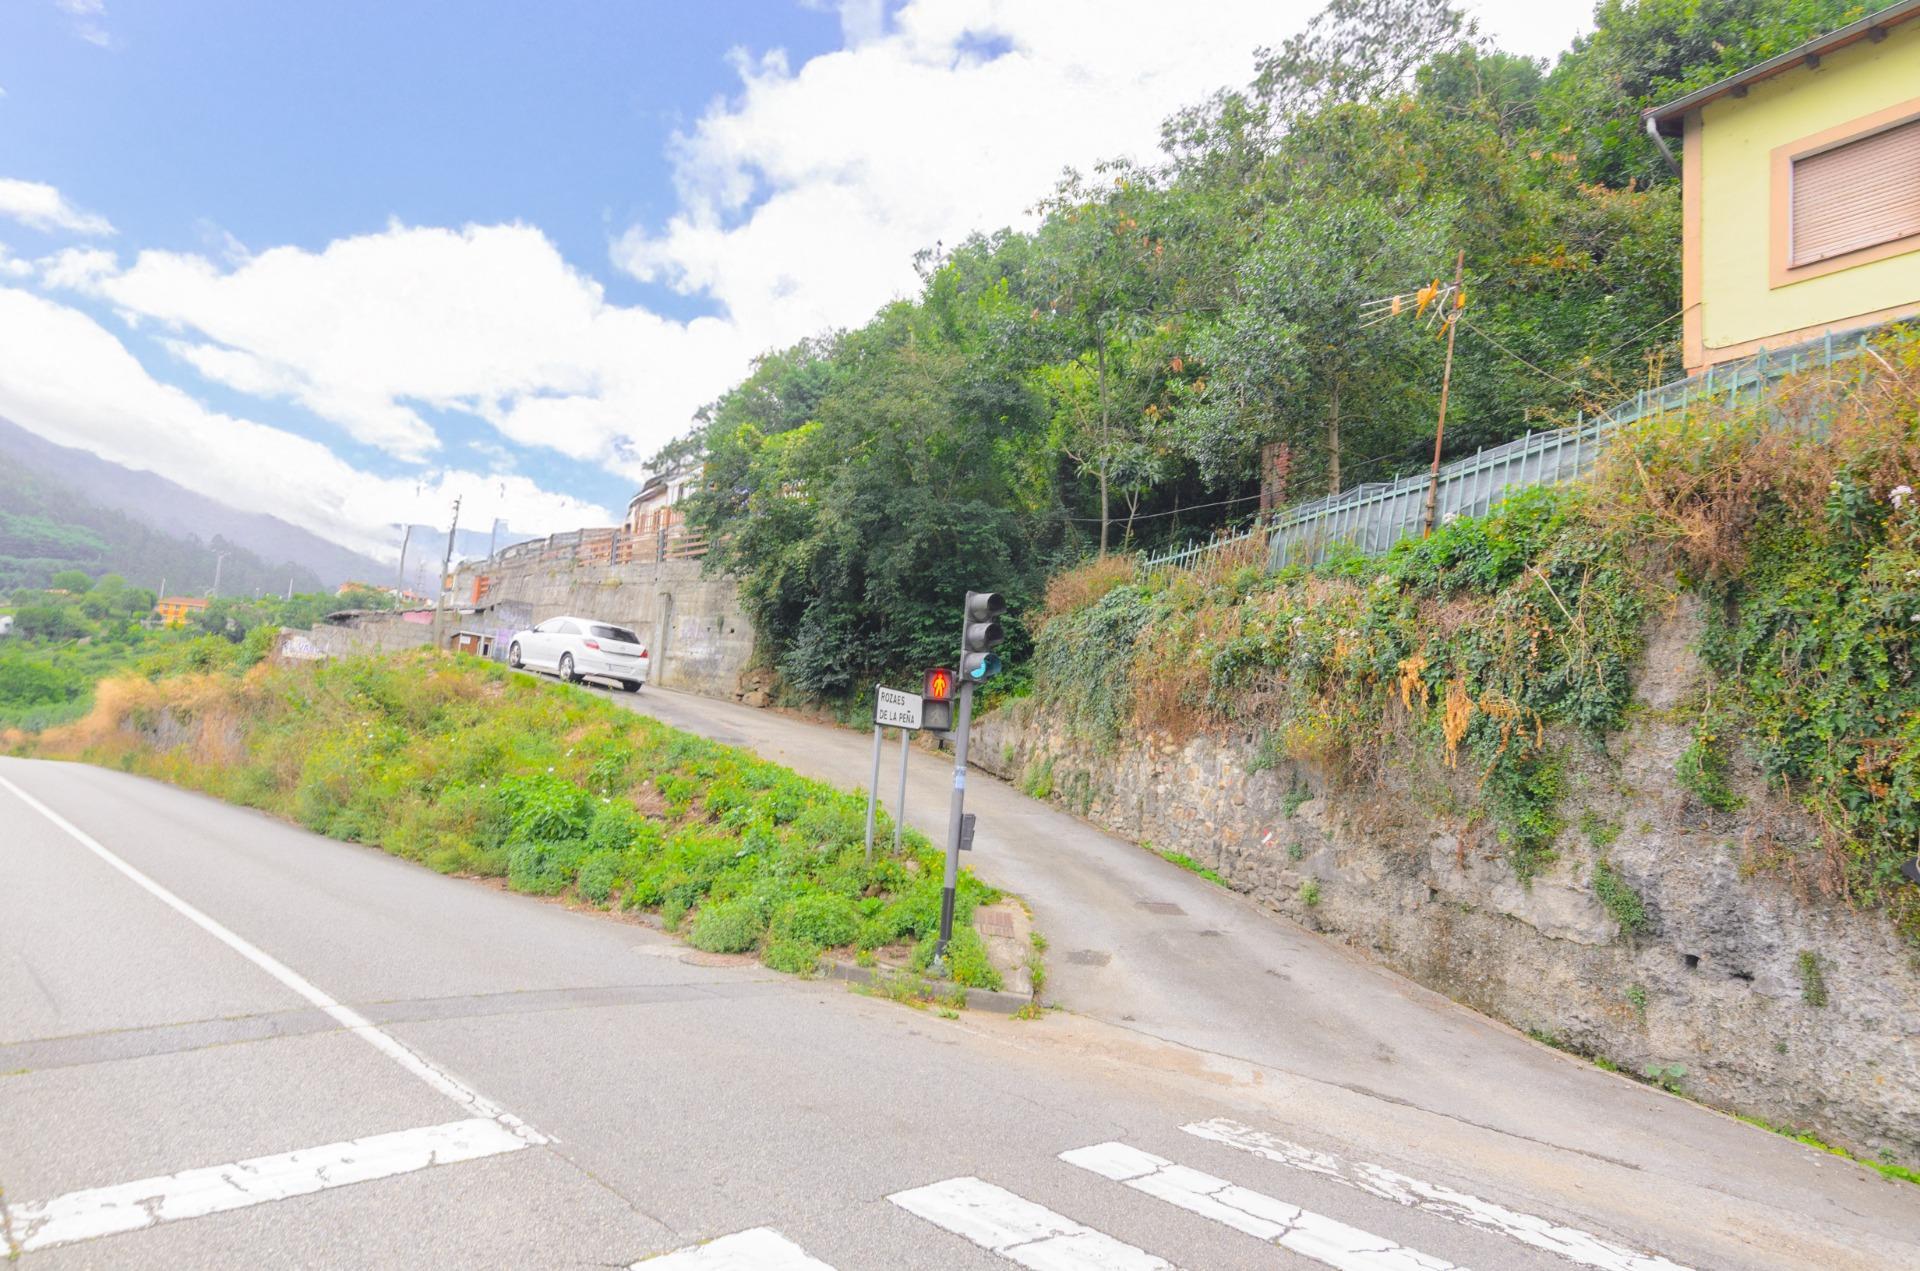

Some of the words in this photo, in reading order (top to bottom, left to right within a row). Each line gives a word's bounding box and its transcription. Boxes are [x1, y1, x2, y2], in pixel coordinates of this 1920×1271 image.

[880, 691, 905, 706] ROZAES
[879, 709, 888, 720] DE
[889, 711, 897, 721] LA
[898, 710, 915, 724] PEÑA
